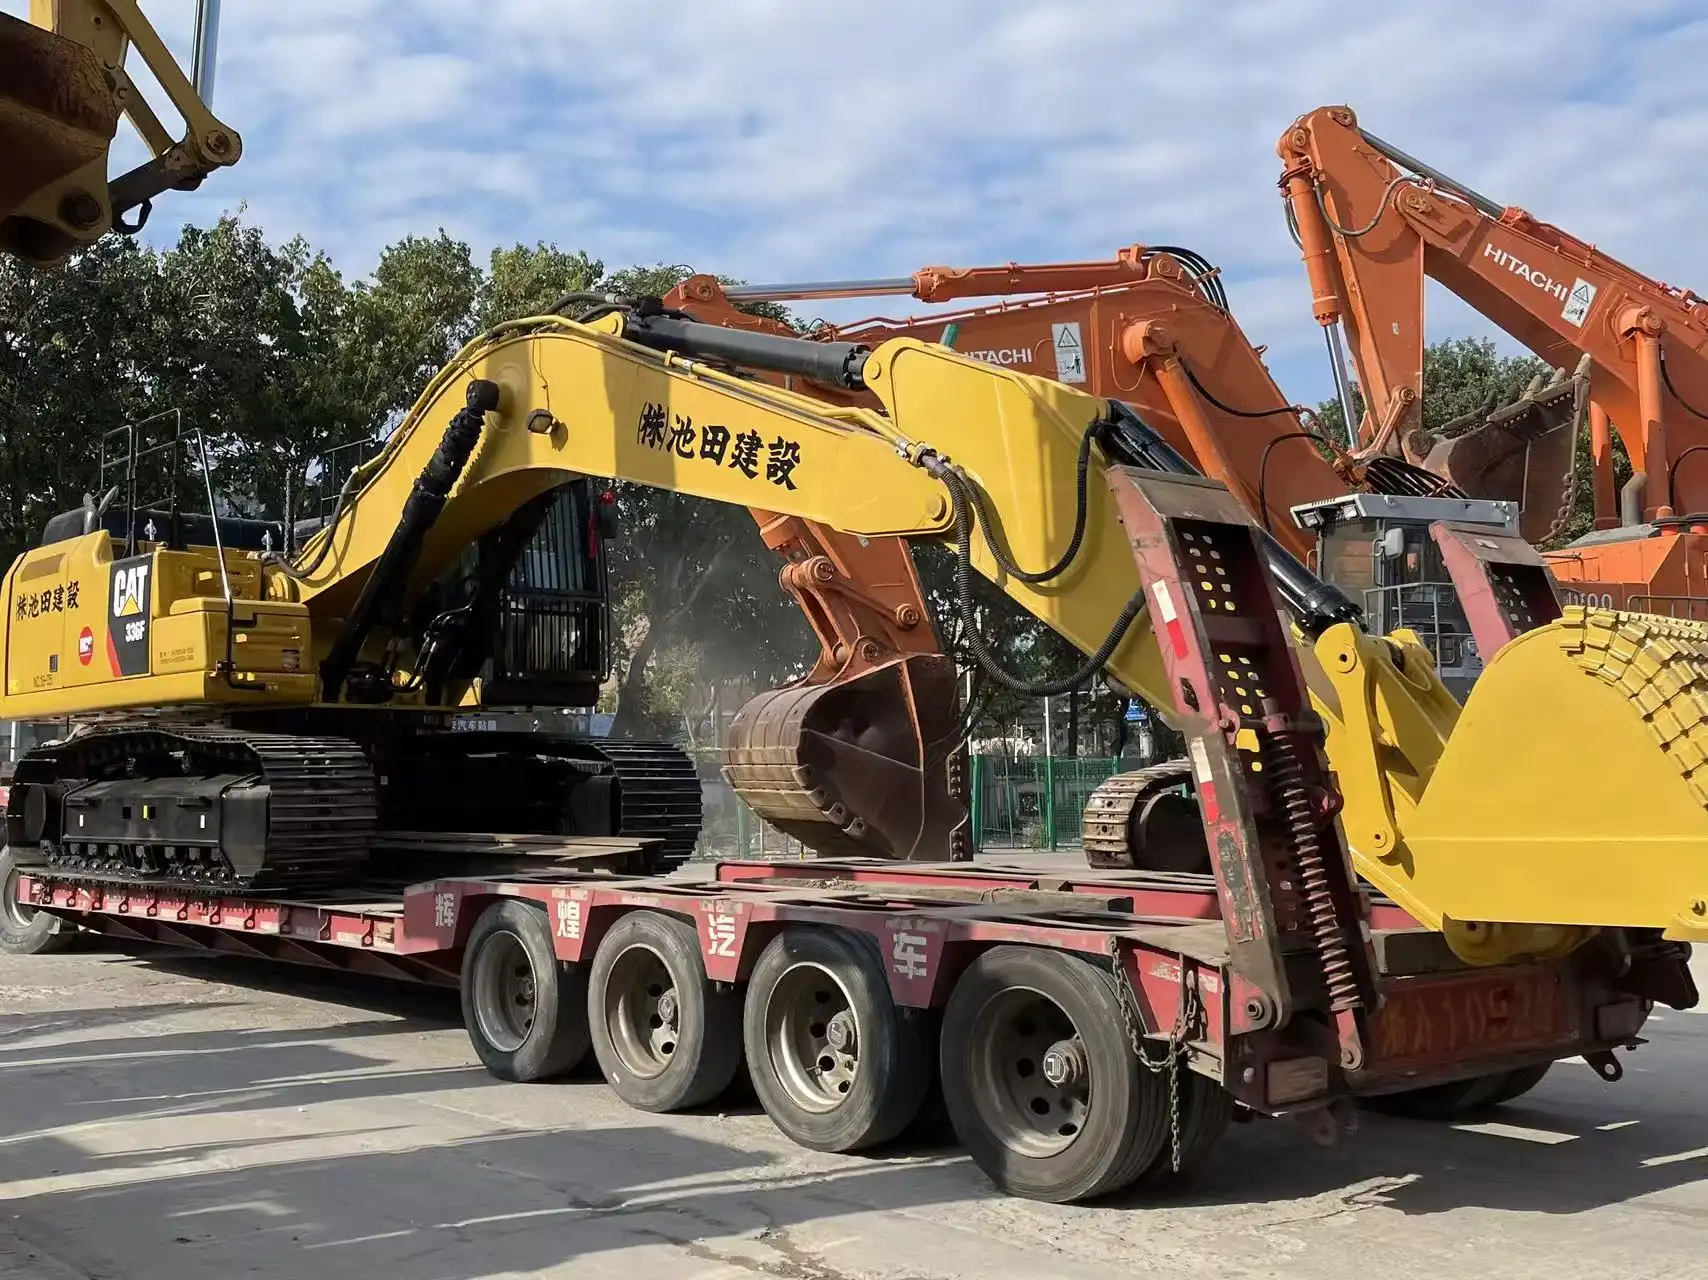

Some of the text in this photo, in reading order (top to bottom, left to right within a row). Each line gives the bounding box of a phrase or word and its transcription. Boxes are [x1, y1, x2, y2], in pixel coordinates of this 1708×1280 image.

[1483, 242, 1569, 302] HITACHI
[964, 347, 1033, 365] ITACHI
[113, 565, 149, 618] CAT
[434, 893, 927, 980] 辉 煌 汽 车
